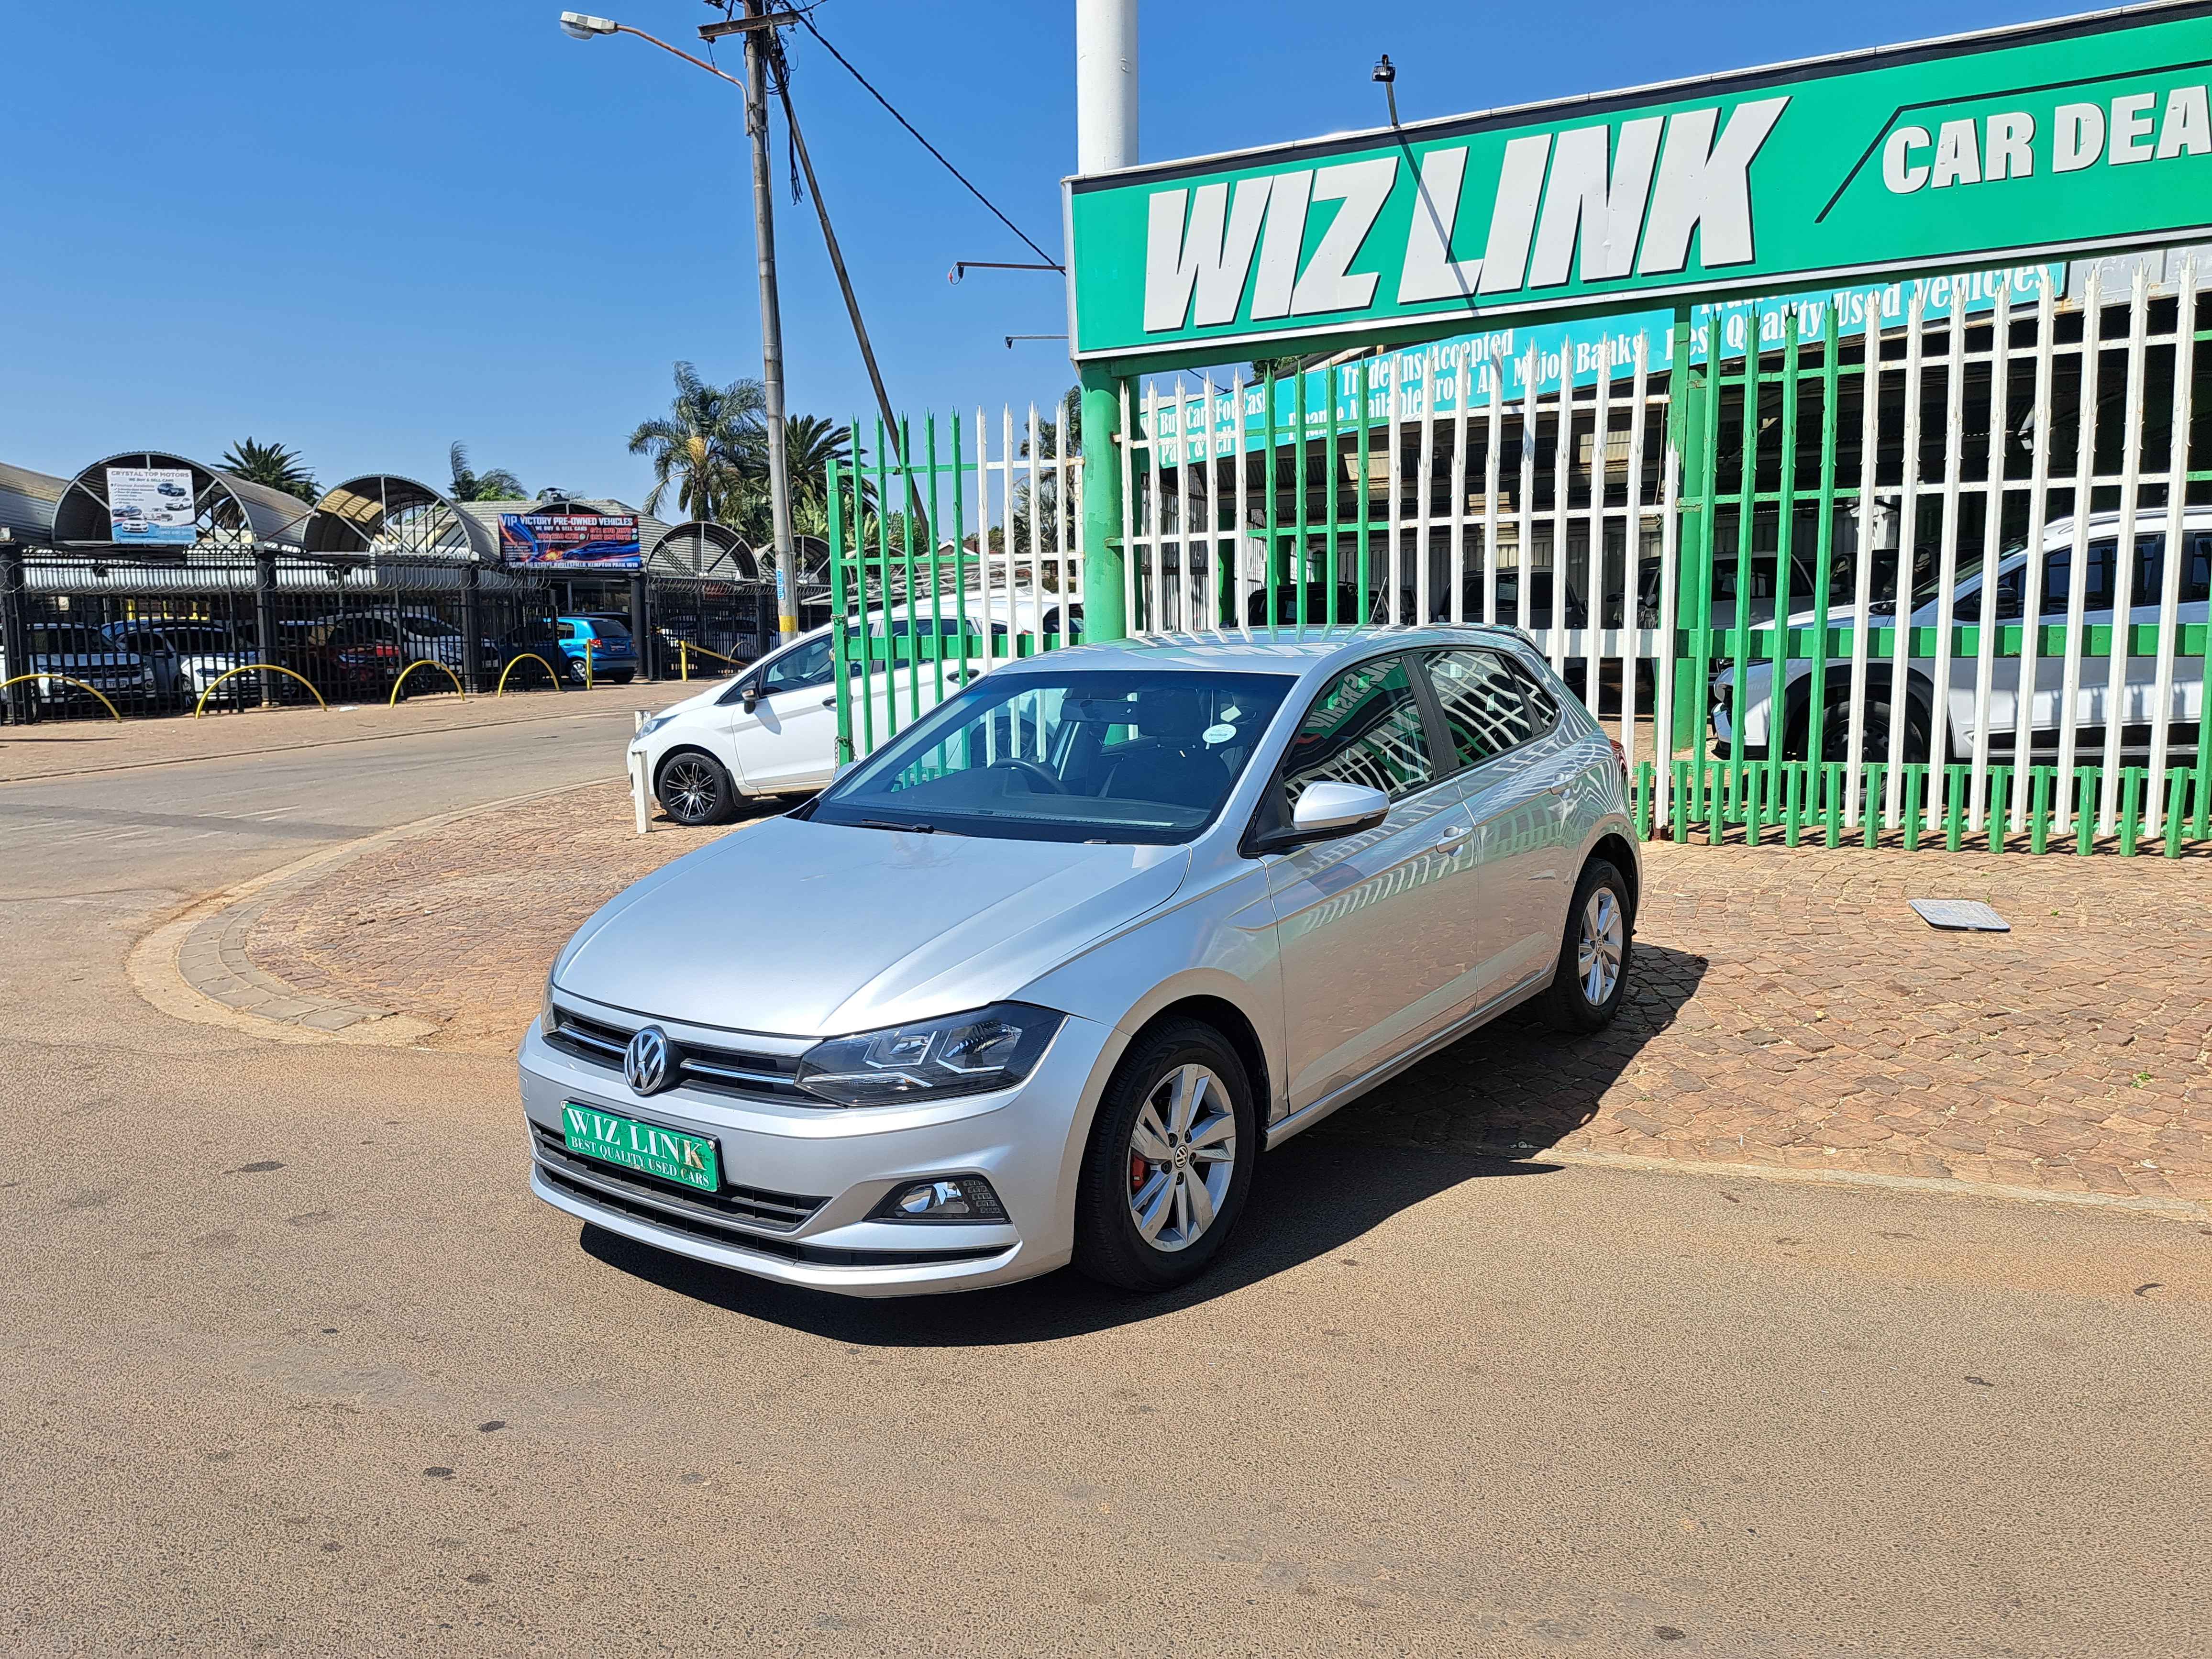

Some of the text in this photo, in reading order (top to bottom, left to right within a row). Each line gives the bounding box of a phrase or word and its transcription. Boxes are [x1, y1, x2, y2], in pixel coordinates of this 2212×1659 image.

[1882, 111, 2036, 194] CAR
[1142, 95, 1793, 332] WIZ LINK
[498, 514, 633, 527] VIP VICTORY PRE-OWNED VEHICLES
[565, 1107, 708, 1171] WIZ LINK
[571, 1135, 710, 1187] BEST QUALITY USED CARS
